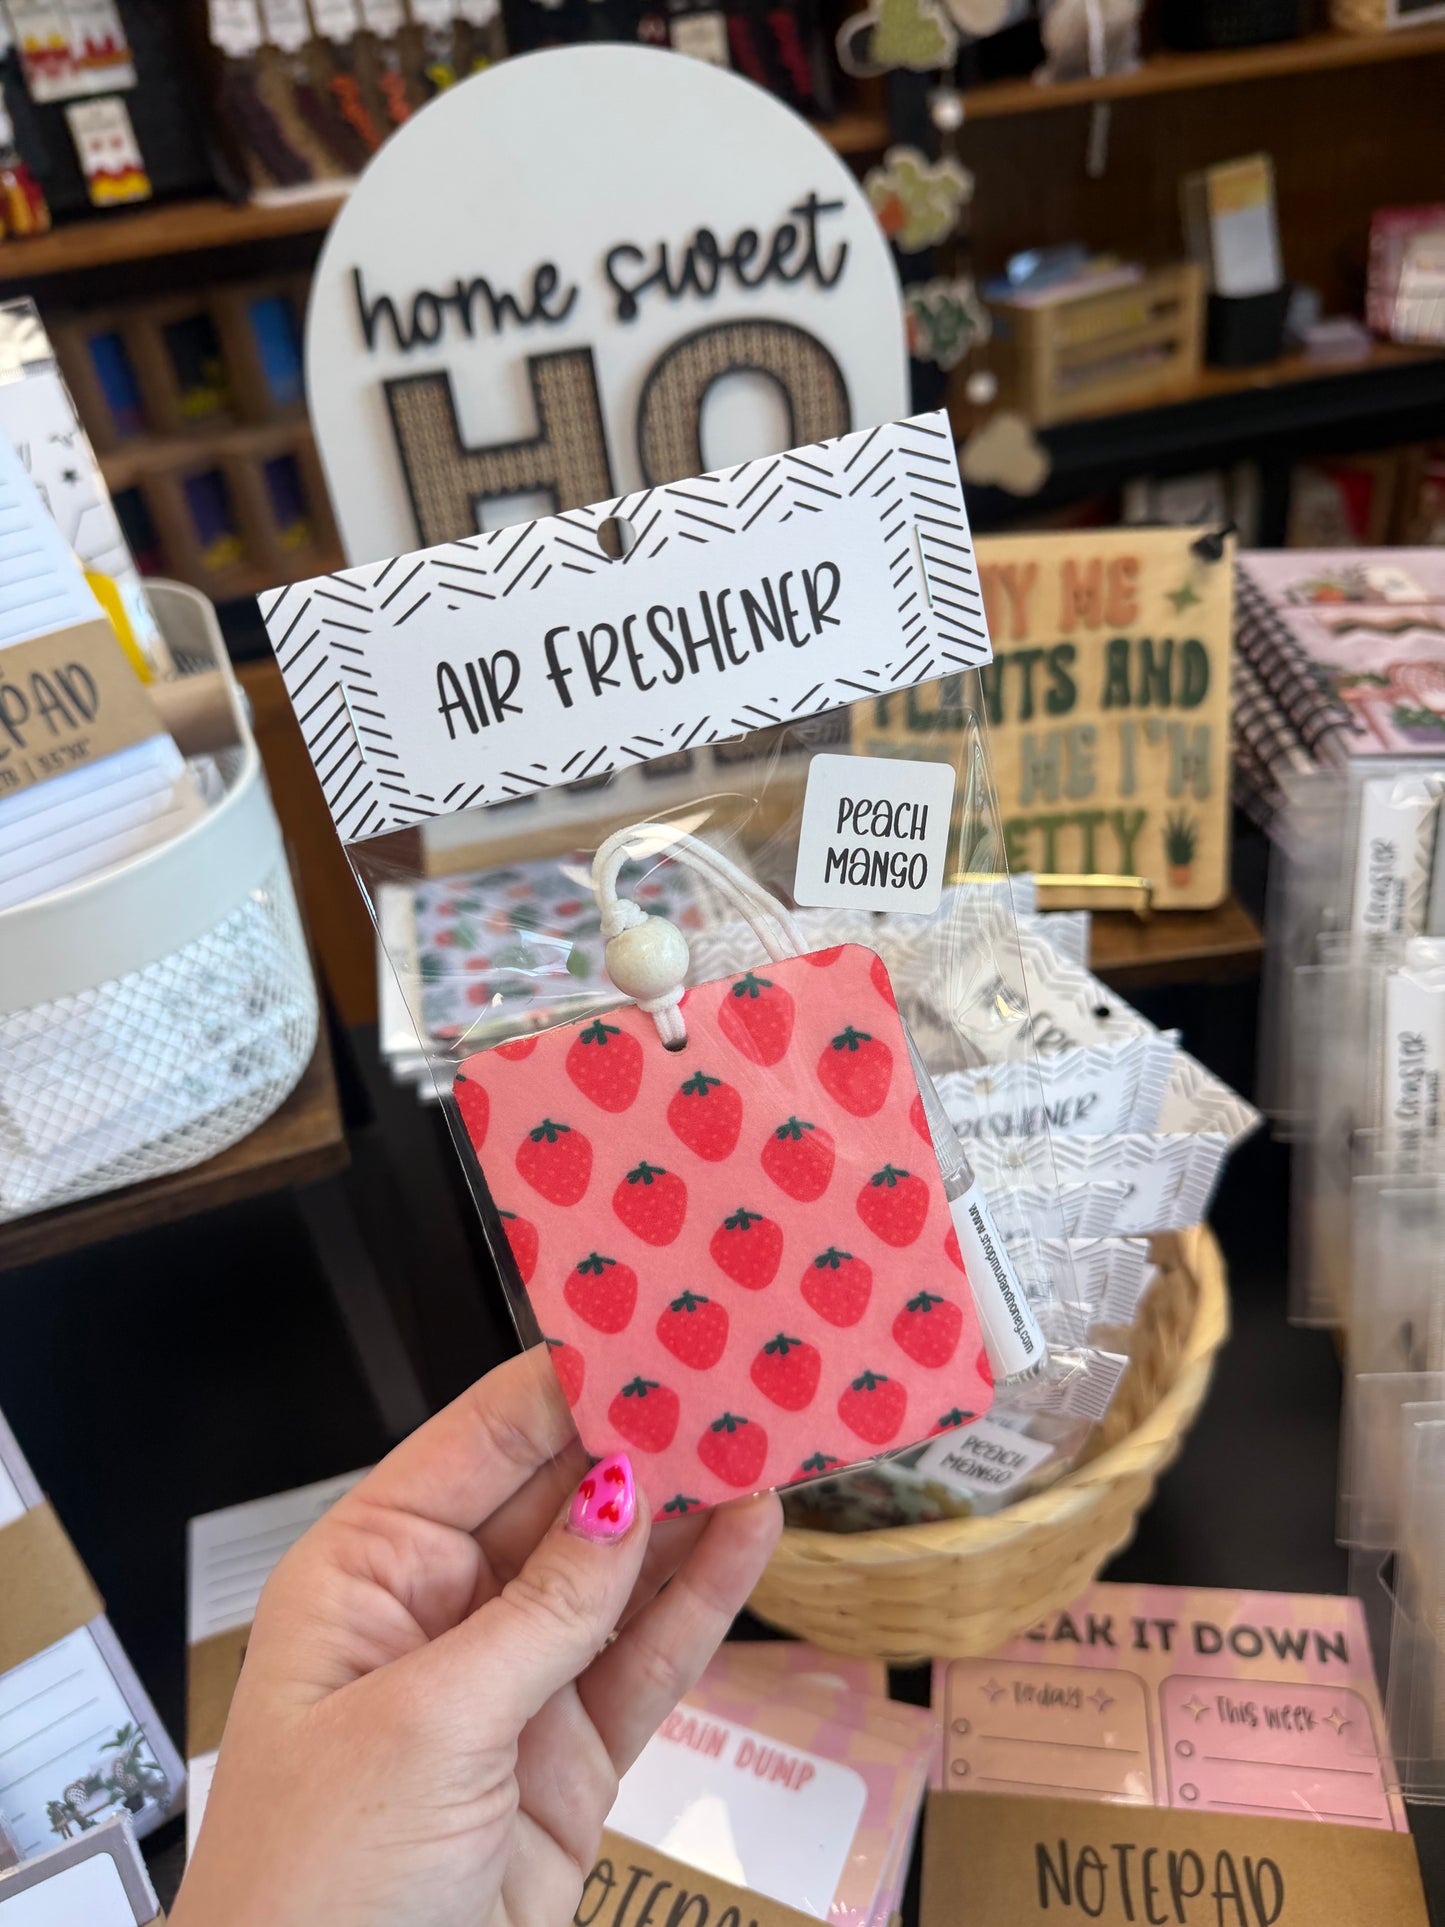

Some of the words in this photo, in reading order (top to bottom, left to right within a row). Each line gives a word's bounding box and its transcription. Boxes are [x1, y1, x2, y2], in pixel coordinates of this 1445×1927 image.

[352, 261, 578, 353] home
[605, 192, 848, 322] sweet
[1058, 556, 1141, 634] ME
[436, 649, 524, 740] AIR
[544, 560, 841, 708] FRESHENER
[1102, 637, 1210, 711] AND
[0, 662, 99, 752] PAD
[1018, 724, 1098, 807] ME
[1116, 717, 1213, 800] I'M
[965, 807, 1146, 878] ETTY
[968, 1202, 1035, 1355] www.shopmudandhoney.com
[1131, 1616, 1178, 1652] IT
[1191, 1620, 1350, 1665] DOWN
[659, 1710, 730, 1759] RAIN
[735, 1737, 816, 1791] DUMP
[1034, 1837, 1285, 1927] NOTEPAD
